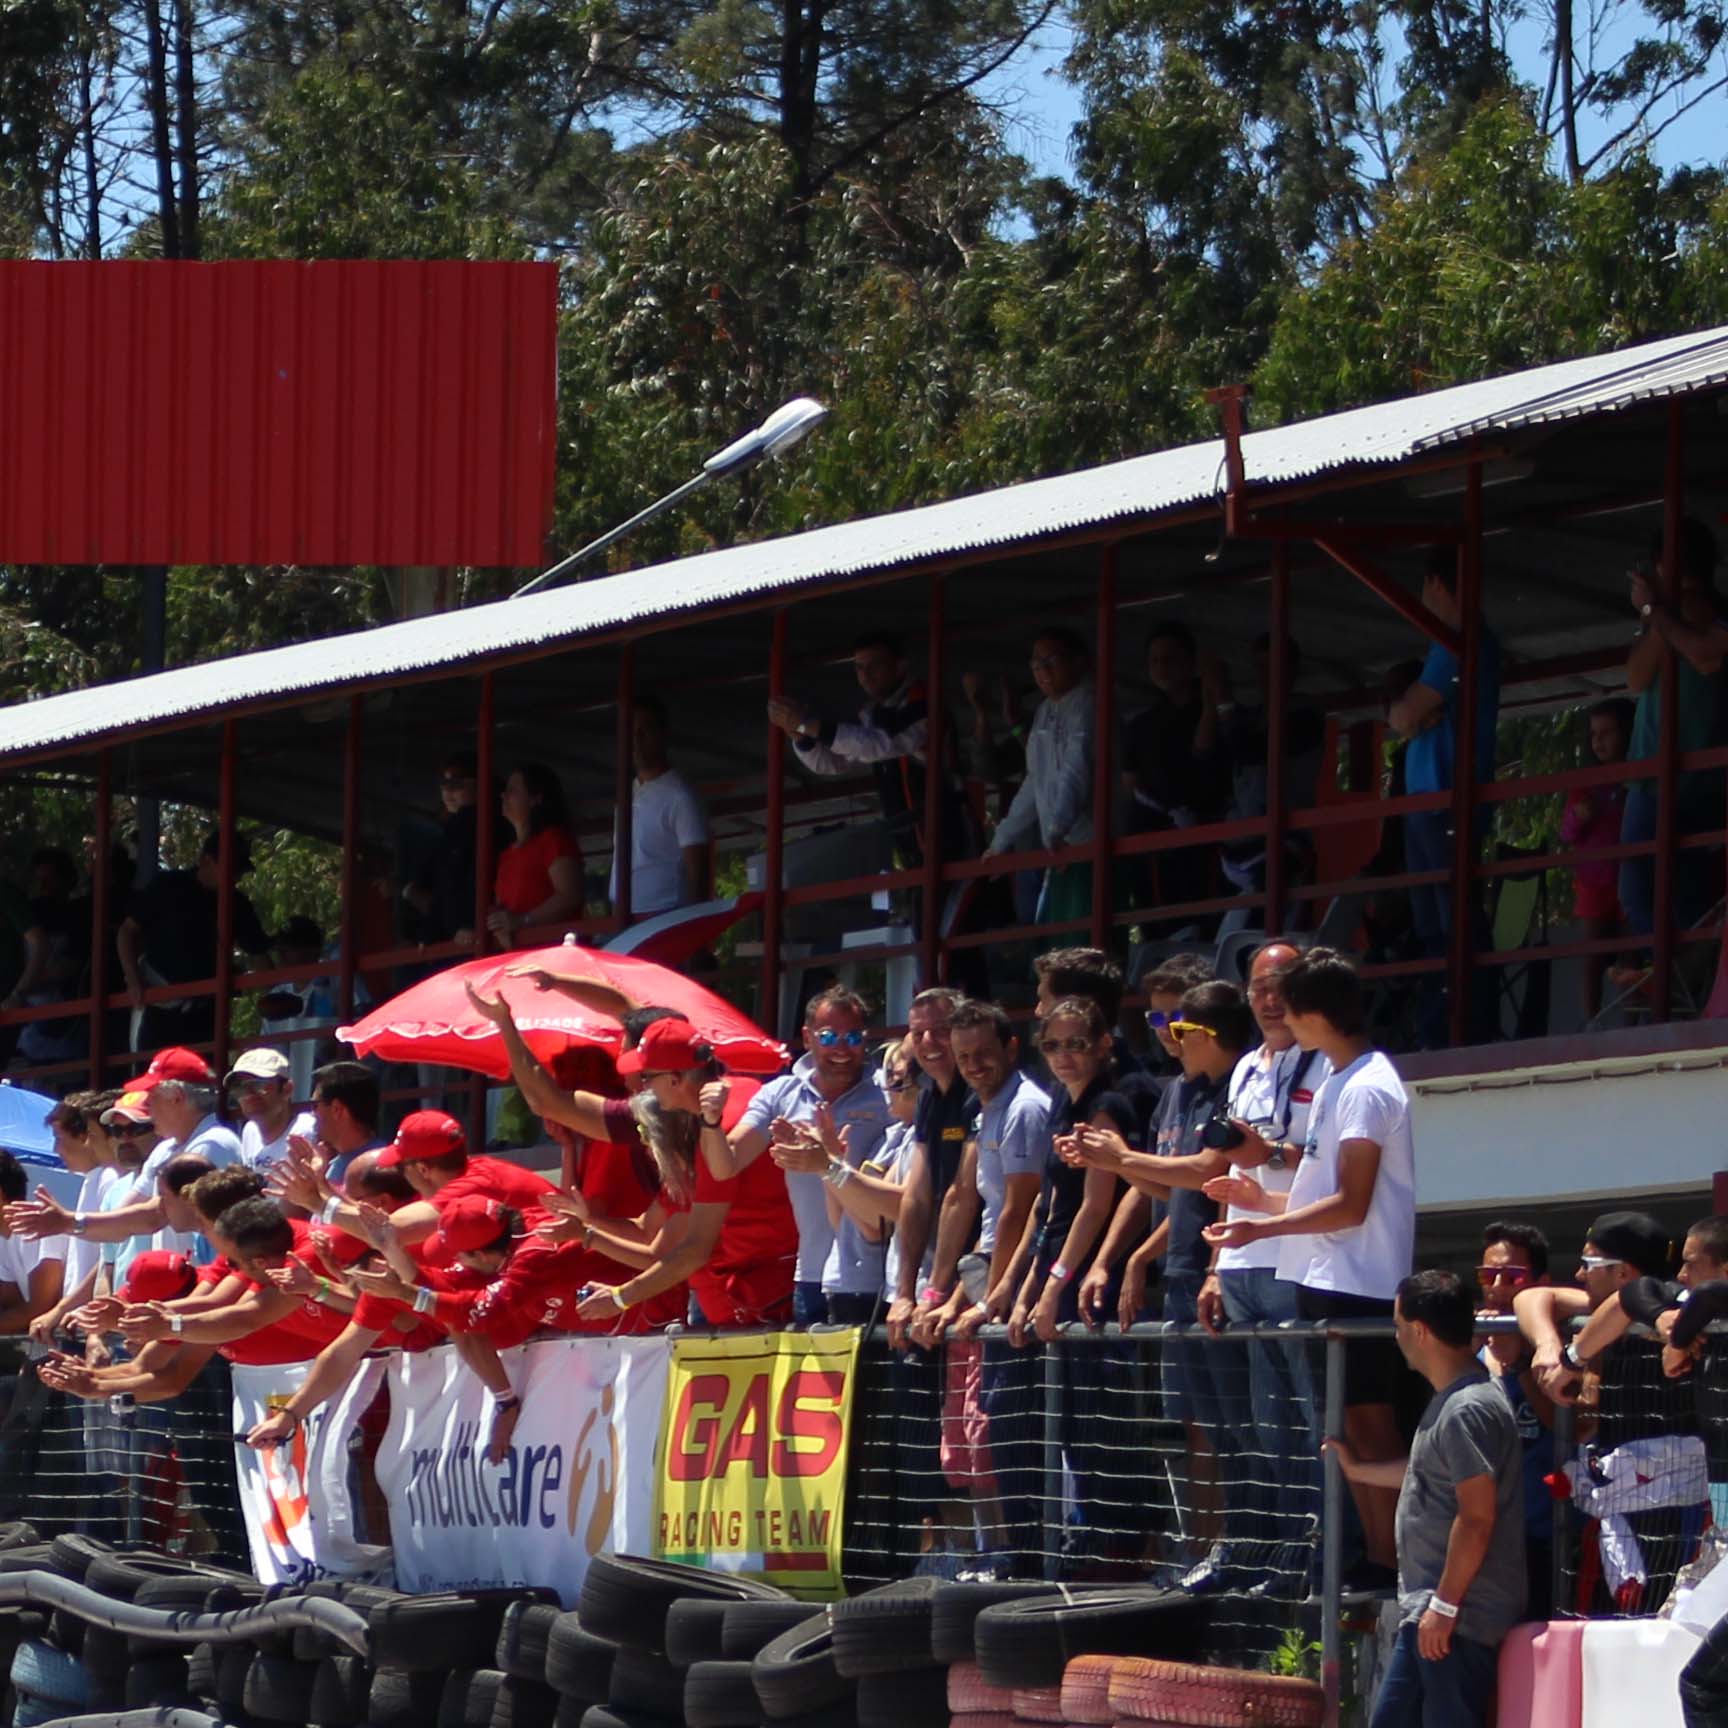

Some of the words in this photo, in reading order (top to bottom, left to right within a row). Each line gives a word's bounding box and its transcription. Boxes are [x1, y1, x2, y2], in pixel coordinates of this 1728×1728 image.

[410, 1420, 563, 1528] multicare
[667, 1369, 845, 1481] GAS
[660, 1510, 743, 1550] RACING
[754, 1508, 832, 1549] TEAM
